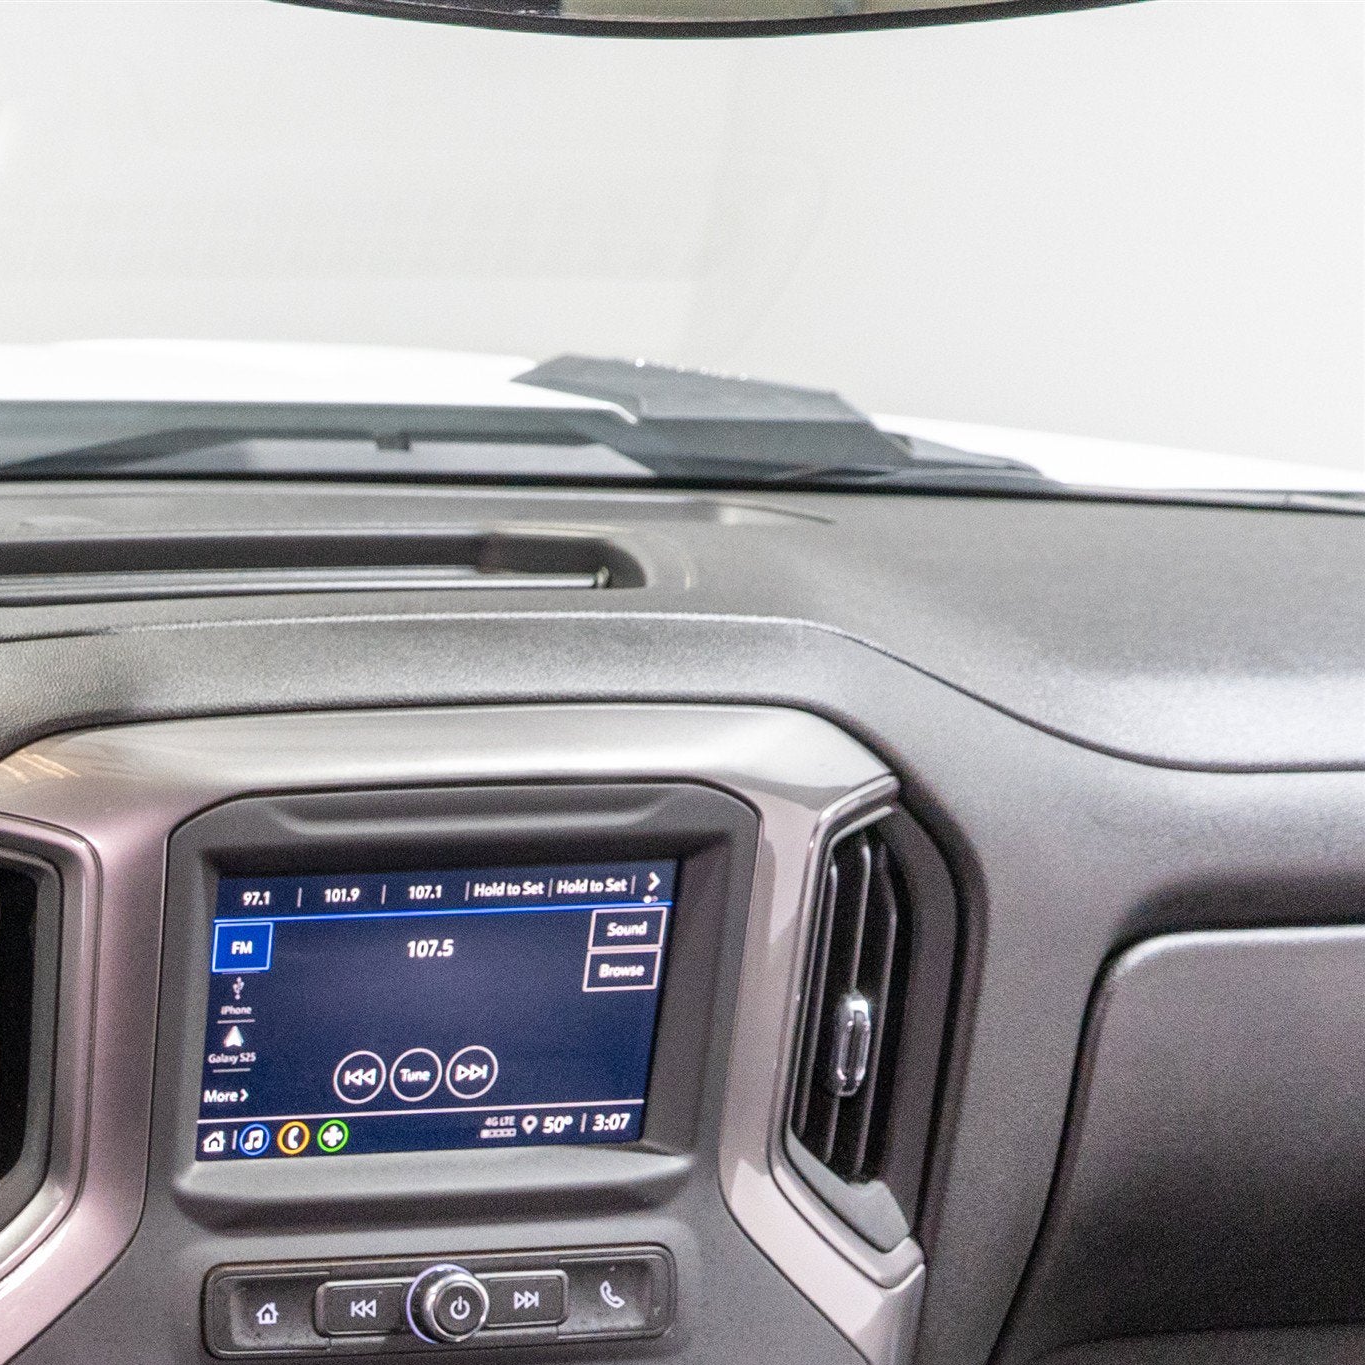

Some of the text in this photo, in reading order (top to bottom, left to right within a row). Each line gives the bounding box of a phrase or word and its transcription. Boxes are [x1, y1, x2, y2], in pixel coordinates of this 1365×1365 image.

[408, 885, 442, 900] 107.1
[473, 881, 545, 897] Hold to Set
[557, 878, 627, 894] Hold to Set
[242, 891, 271, 906] 97.1
[324, 888, 360, 903] 101.9
[606, 921, 648, 937] Sound
[231, 941, 253, 955] FM
[407, 938, 454, 958] 107.5
[598, 963, 645, 978] Browse
[220, 1005, 252, 1015] iPhone
[207, 1052, 256, 1066] Galaxy S25
[399, 1068, 431, 1082] Tune
[203, 1089, 239, 1103] More
[484, 1115, 516, 1126] 4G LTE
[592, 1113, 631, 1131] 3:07
